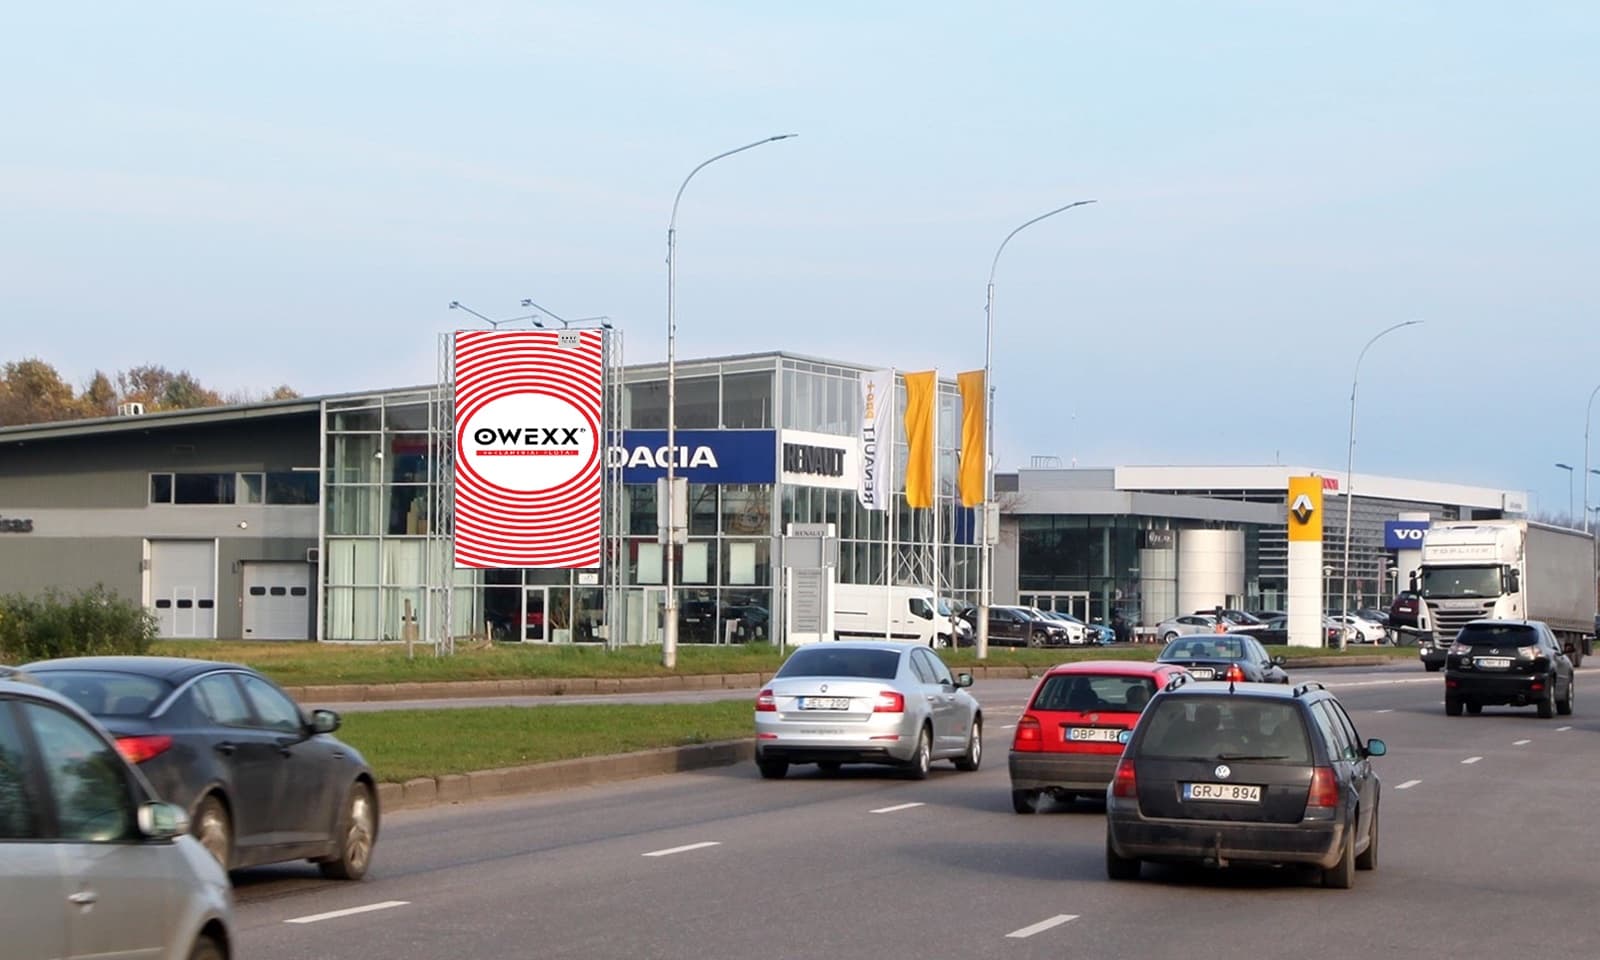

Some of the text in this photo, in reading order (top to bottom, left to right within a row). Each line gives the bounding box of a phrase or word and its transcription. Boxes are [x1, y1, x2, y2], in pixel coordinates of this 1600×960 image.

[606, 446, 719, 469] DACIA
[783, 443, 846, 477] RENAULT
[1072, 729, 1120, 739] DBP 18
[1192, 785, 1257, 800] GRJ 894
